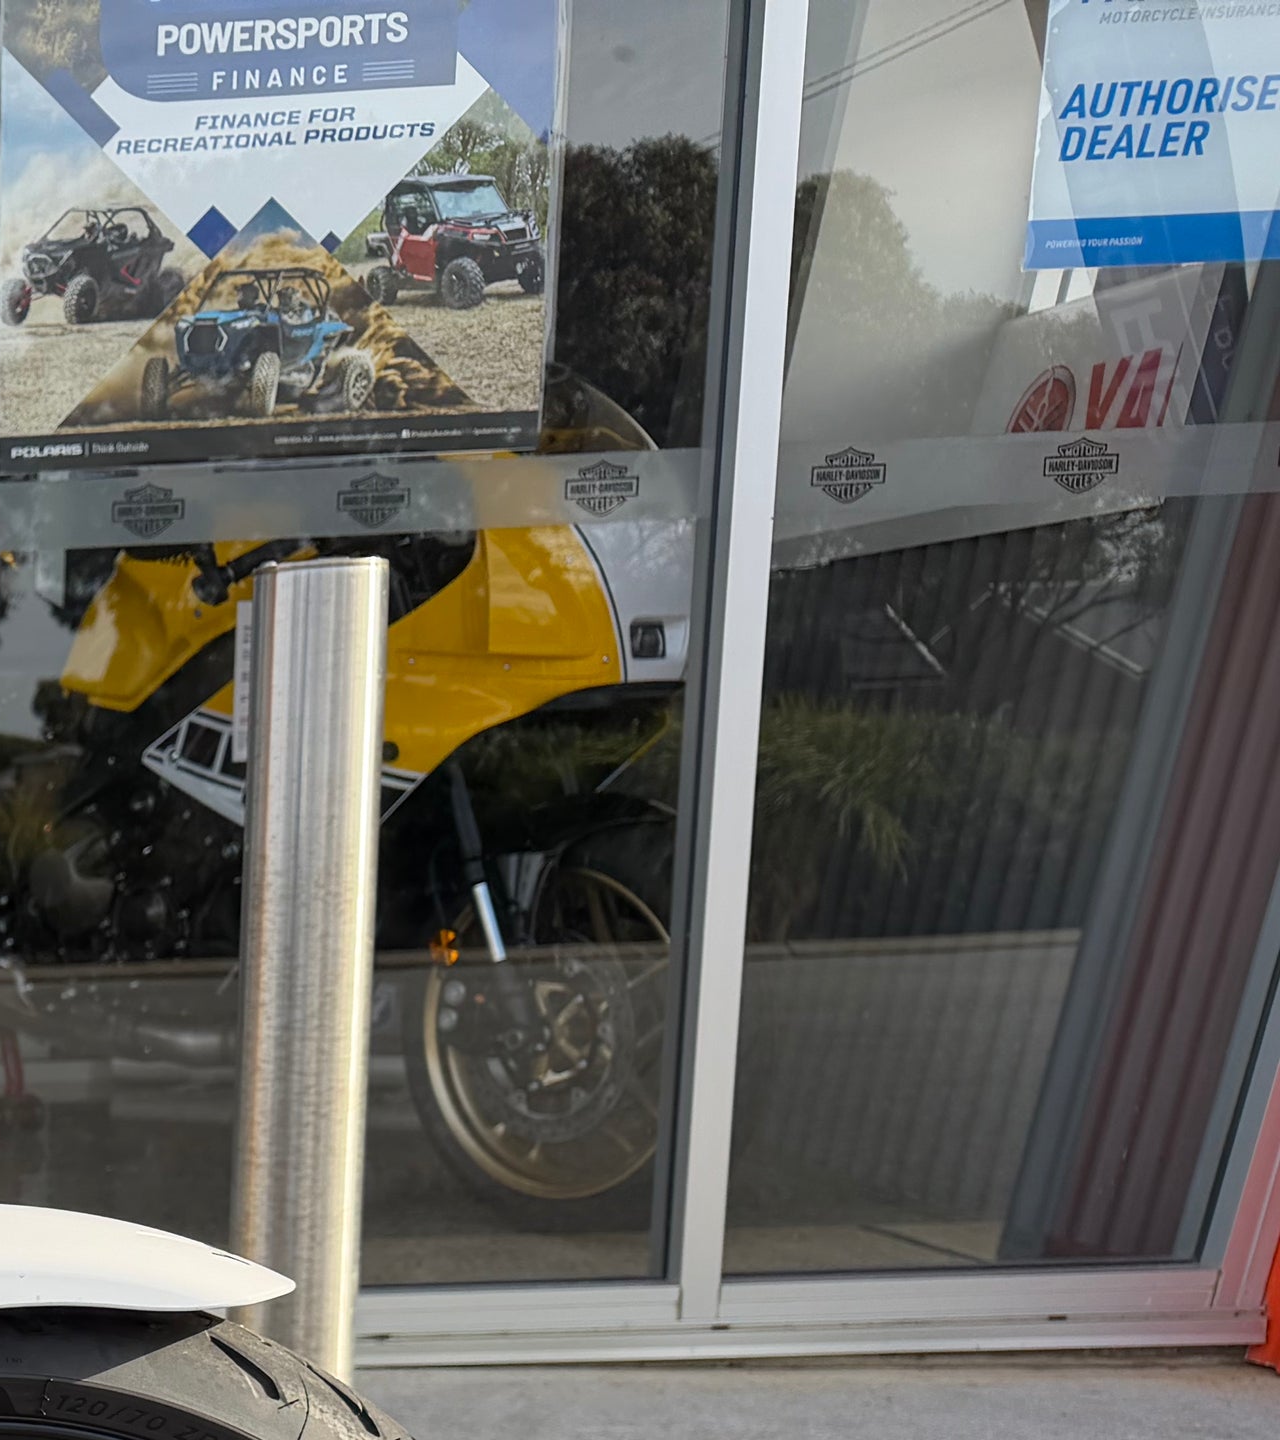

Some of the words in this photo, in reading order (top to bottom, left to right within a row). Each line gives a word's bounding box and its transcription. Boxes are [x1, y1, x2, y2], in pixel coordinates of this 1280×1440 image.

[1099, 8, 1198, 24] MOTORCYCLE
[157, 12, 409, 56] POWERSPORTS
[212, 64, 349, 91] FINANCE
[195, 110, 300, 130] FINANCE
[308, 107, 356, 124] FOR
[116, 132, 297, 155] RECREATIONAL
[304, 122, 435, 144] PRODUCTS
[1058, 120, 1210, 162] DEALER
[1088, 238, 1108, 247] YOUR
[1109, 236, 1143, 246] PASSION
[10, 443, 83, 459] POLARIS
[816, 469, 881, 481] HARLEY-DAVIDSON
[1048, 458, 1114, 472] HARLEY-DAVIDSON
[56, 1394, 167, 1431] 120/70
